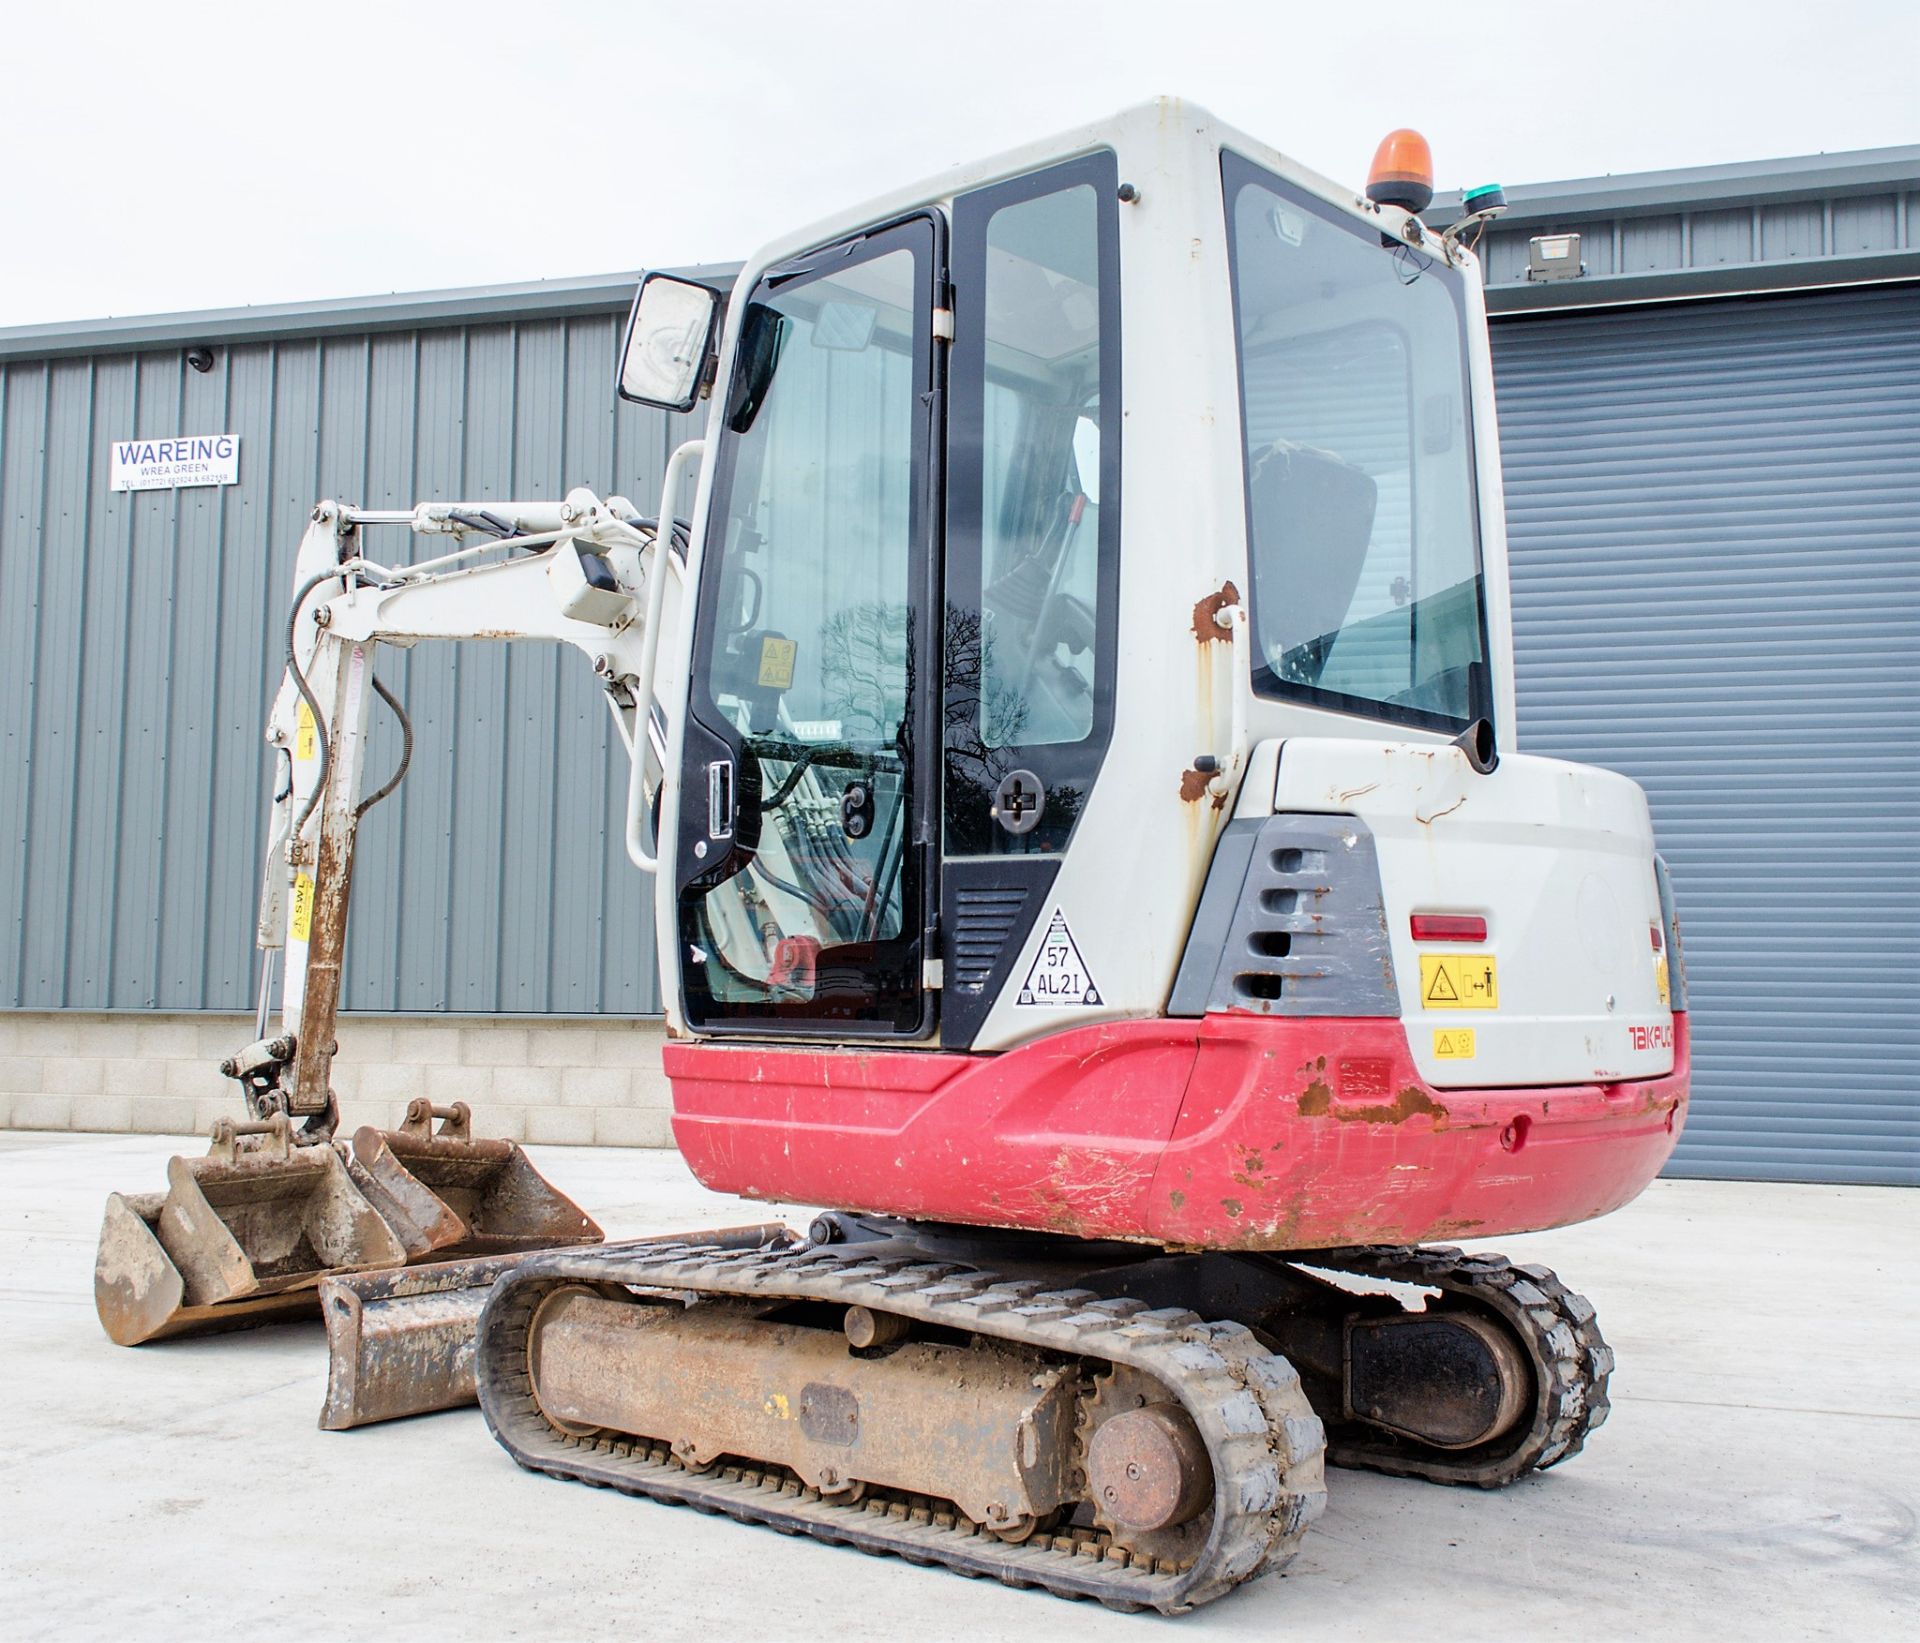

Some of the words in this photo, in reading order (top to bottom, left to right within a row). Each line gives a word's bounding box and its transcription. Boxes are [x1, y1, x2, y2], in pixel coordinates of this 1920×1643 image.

[119, 439, 232, 465] WAREING
[141, 465, 171, 476] WREA
[174, 463, 208, 475] GREEN
[295, 879, 306, 911] SWL
[1047, 946, 1069, 967] 57
[1628, 1025, 1672, 1050] TAKEUC
